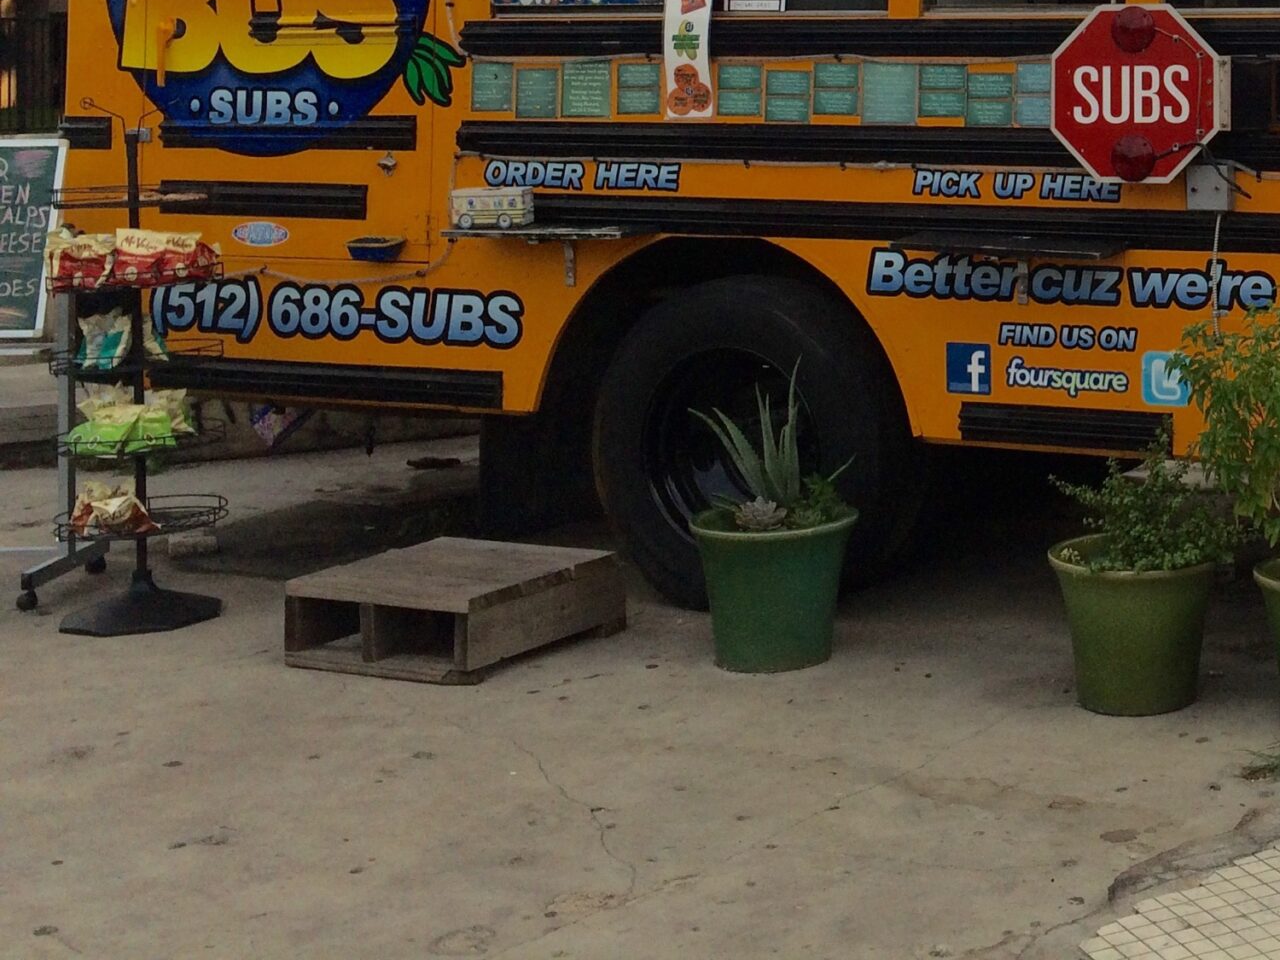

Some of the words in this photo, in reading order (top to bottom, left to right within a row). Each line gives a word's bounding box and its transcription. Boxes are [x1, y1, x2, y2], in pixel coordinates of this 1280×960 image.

[208, 90, 318, 126] SUBS
[1072, 65, 1191, 125] SUBS
[486, 162, 583, 188] ORDER
[595, 163, 680, 189] HERE
[914, 170, 980, 197] PICK
[995, 173, 1034, 197] UP
[1041, 174, 1121, 200] HERE
[870, 251, 1021, 297] Better
[1031, 266, 1119, 303] cuz
[152, 282, 259, 338] (512)
[271, 287, 521, 344] 686-SUBS
[1000, 325, 1054, 346] FIND
[1061, 328, 1093, 348] US
[1100, 330, 1136, 350] ON
[1008, 358, 1127, 396] foursquare
